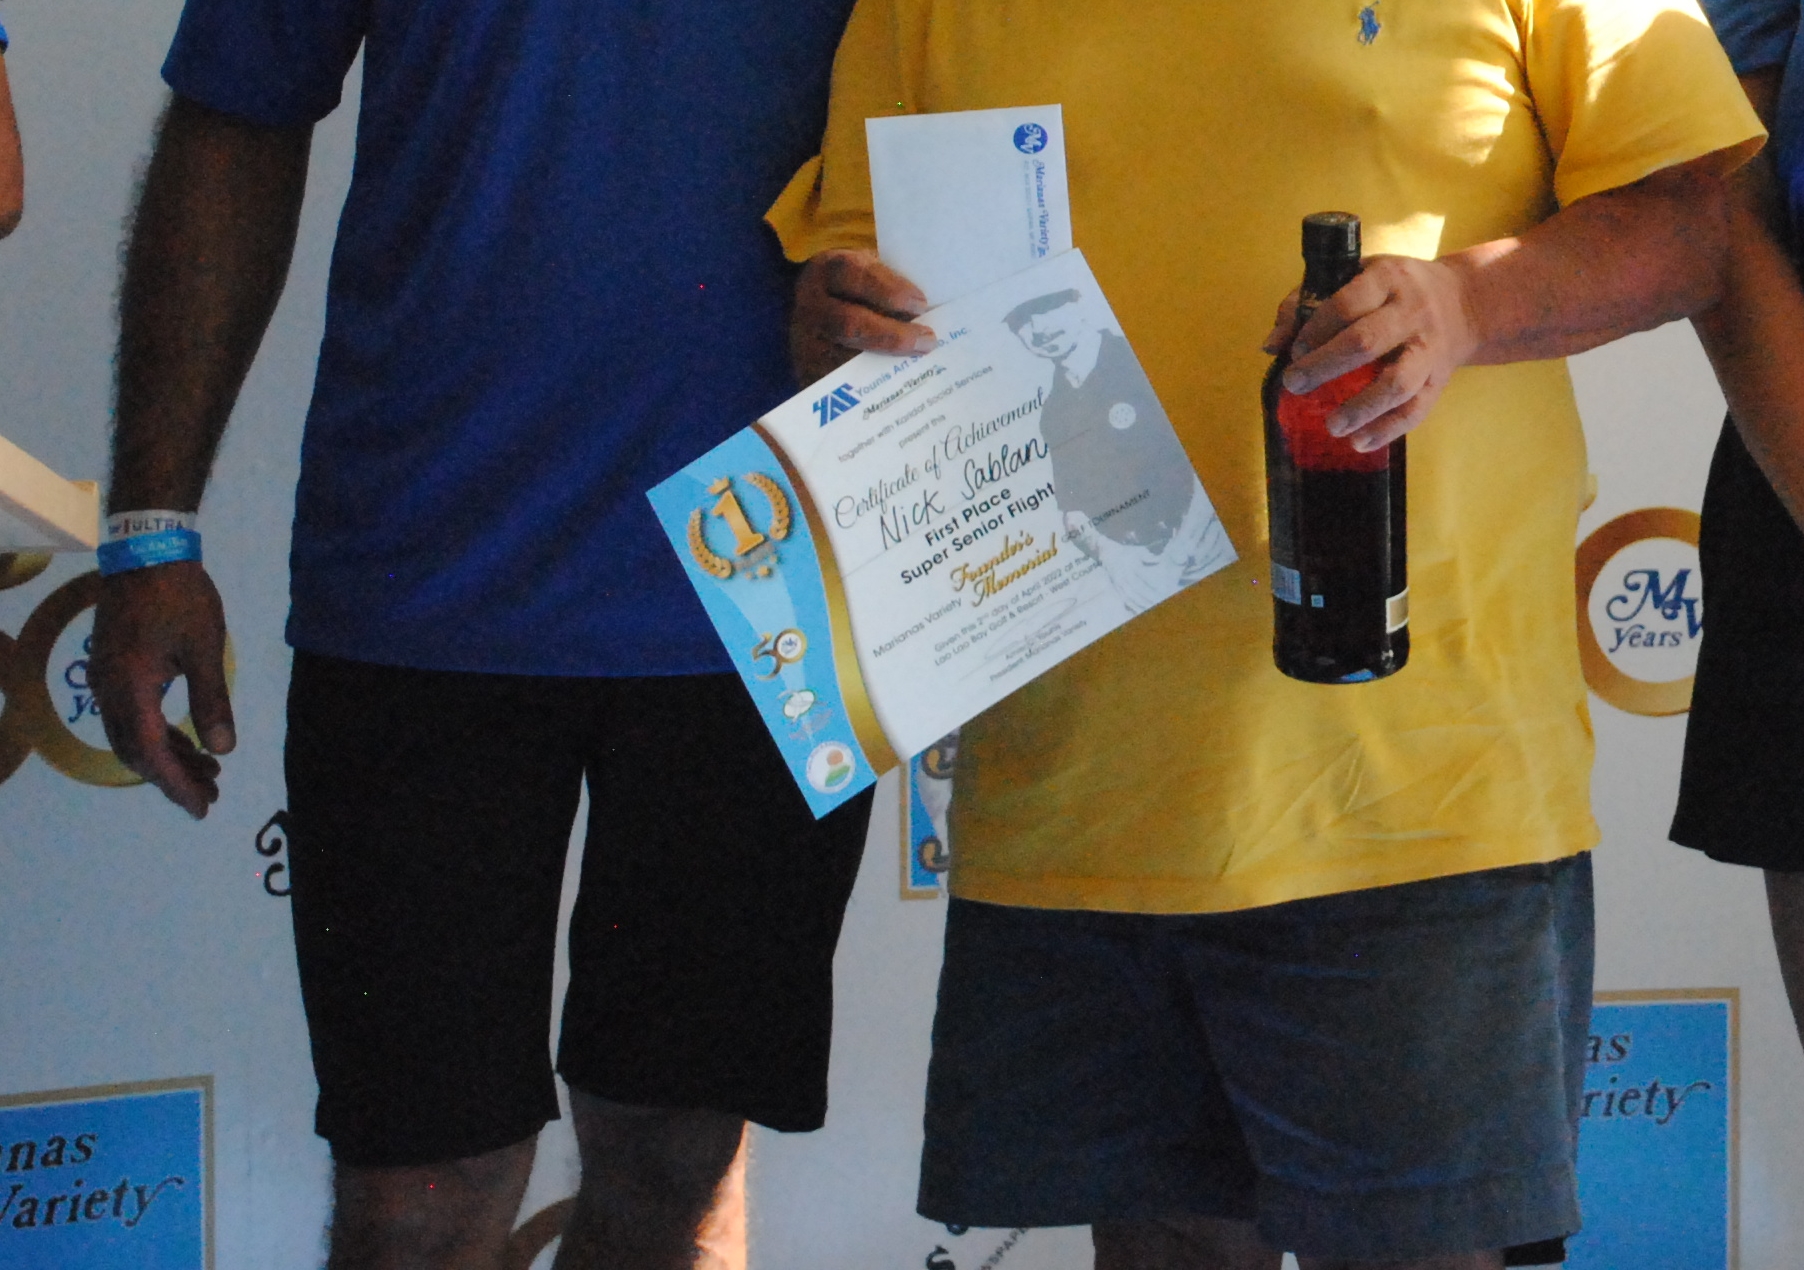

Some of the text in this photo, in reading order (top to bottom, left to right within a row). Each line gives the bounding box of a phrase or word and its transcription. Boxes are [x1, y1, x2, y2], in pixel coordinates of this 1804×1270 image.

[855, 373, 892, 397] Younis
[892, 359, 910, 375] Art
[863, 367, 934, 420] Marianas Variety
[838, 436, 876, 462] together
[876, 424, 895, 439] with
[926, 387, 953, 407] Social
[955, 364, 993, 389] Services
[898, 413, 947, 448] present this
[834, 385, 1045, 529] Certificate of Achievement
[961, 438, 1048, 500] Sablan
[900, 482, 1056, 584] Super Senior Flight
[924, 487, 1012, 546] First Place
[950, 530, 1035, 592] Founder's
[872, 596, 962, 659] Marianas Variety
[934, 631, 961, 652] Given
[961, 622, 977, 635] this
[991, 604, 1009, 618] day
[1021, 581, 1042, 599] April
[934, 652, 953, 667] Lao
[953, 640, 970, 655] Lao
[970, 629, 988, 644] Bay
[988, 614, 1008, 632] Golf
[1608, 624, 1683, 653] years
[1580, 1076, 1711, 1125] riety
